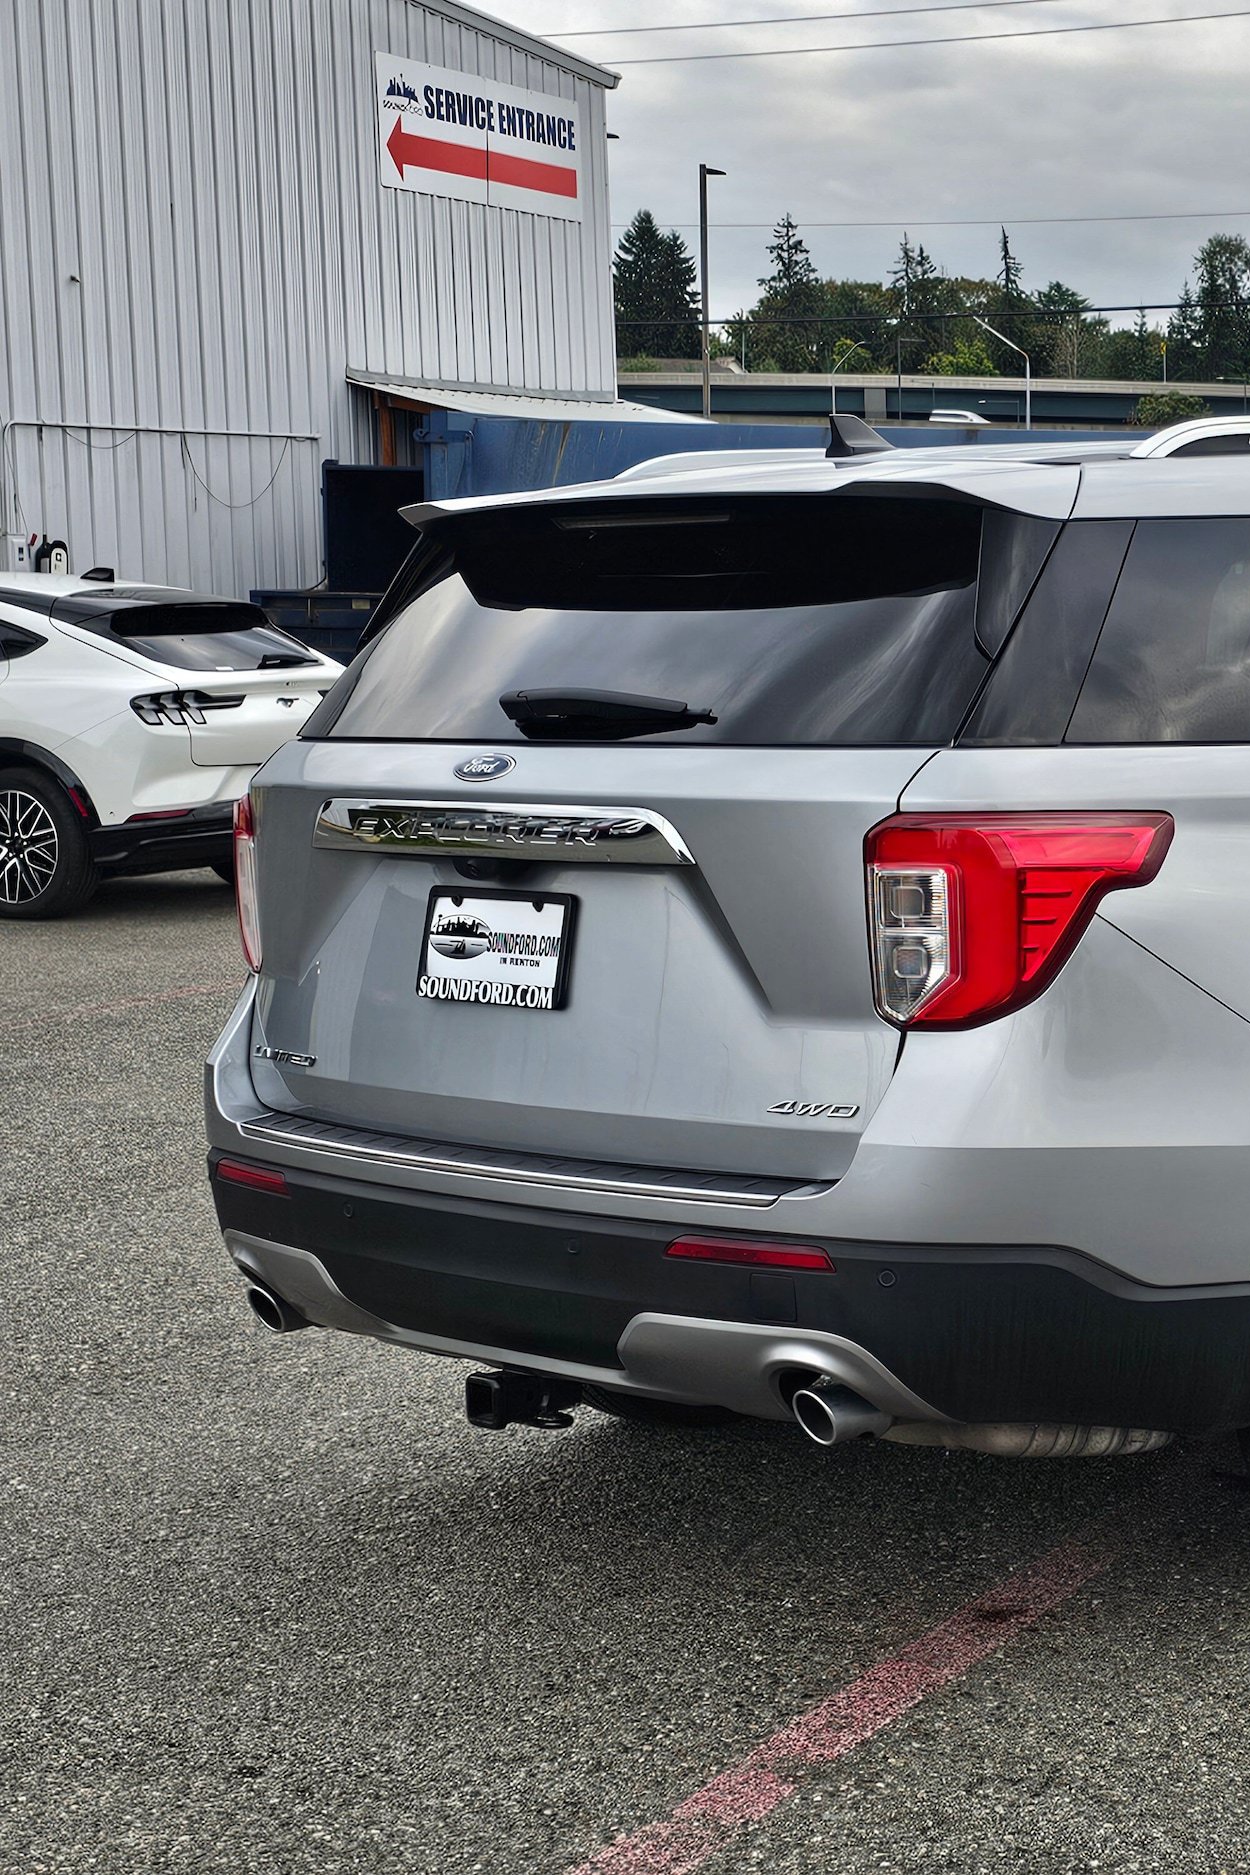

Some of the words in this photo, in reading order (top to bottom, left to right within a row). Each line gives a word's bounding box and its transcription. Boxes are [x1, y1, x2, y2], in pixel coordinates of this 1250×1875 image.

[423, 84, 495, 132] SERVICE
[498, 102, 576, 151] ENTRANCE
[463, 758, 500, 773] Ford
[352, 816, 599, 846] EXPLORER
[486, 931, 561, 958] SOUNDFORD.COM
[417, 975, 553, 1010] SOUNDFORD.COM
[766, 1100, 860, 1118] 4WD
